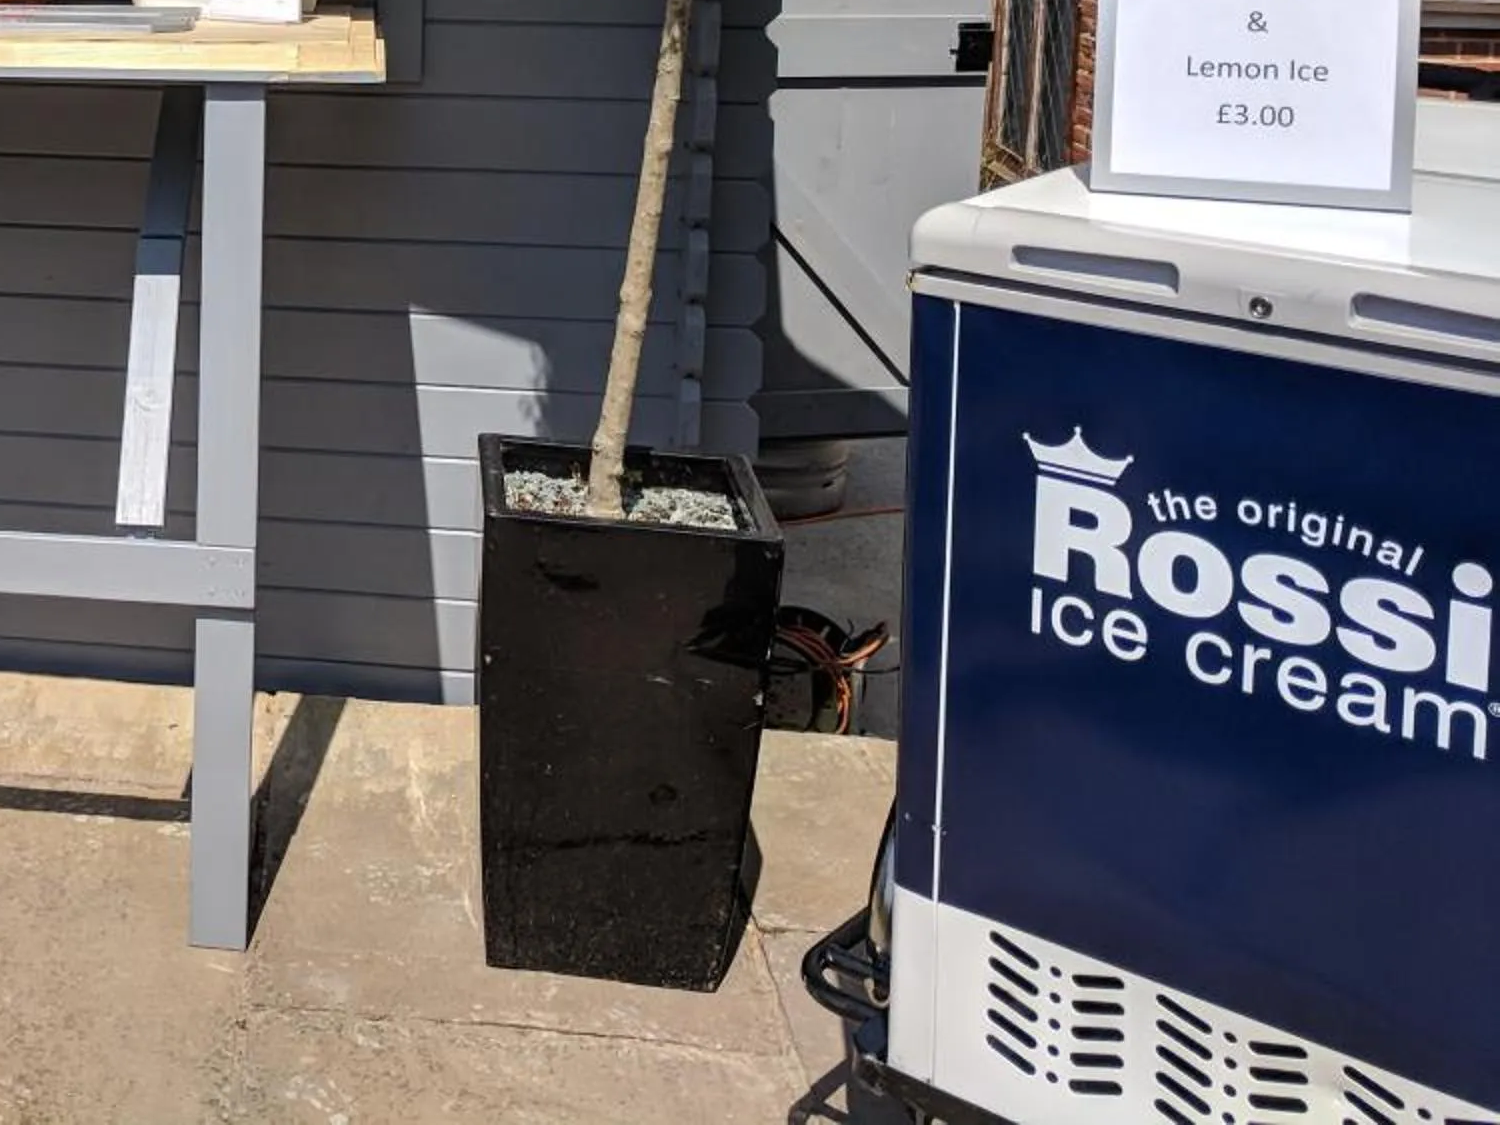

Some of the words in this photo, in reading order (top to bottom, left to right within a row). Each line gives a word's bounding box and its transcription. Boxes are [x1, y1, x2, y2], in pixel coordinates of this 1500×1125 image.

[1246, 10, 1269, 34] &
[1186, 56, 1280, 81] Lemon
[1289, 60, 1330, 83] Ice
[1216, 104, 1295, 128] £3.00
[1147, 489, 1218, 523] the
[1236, 498, 1425, 576] original
[1032, 475, 1493, 693] Rossi
[1184, 631, 1488, 760] cream
